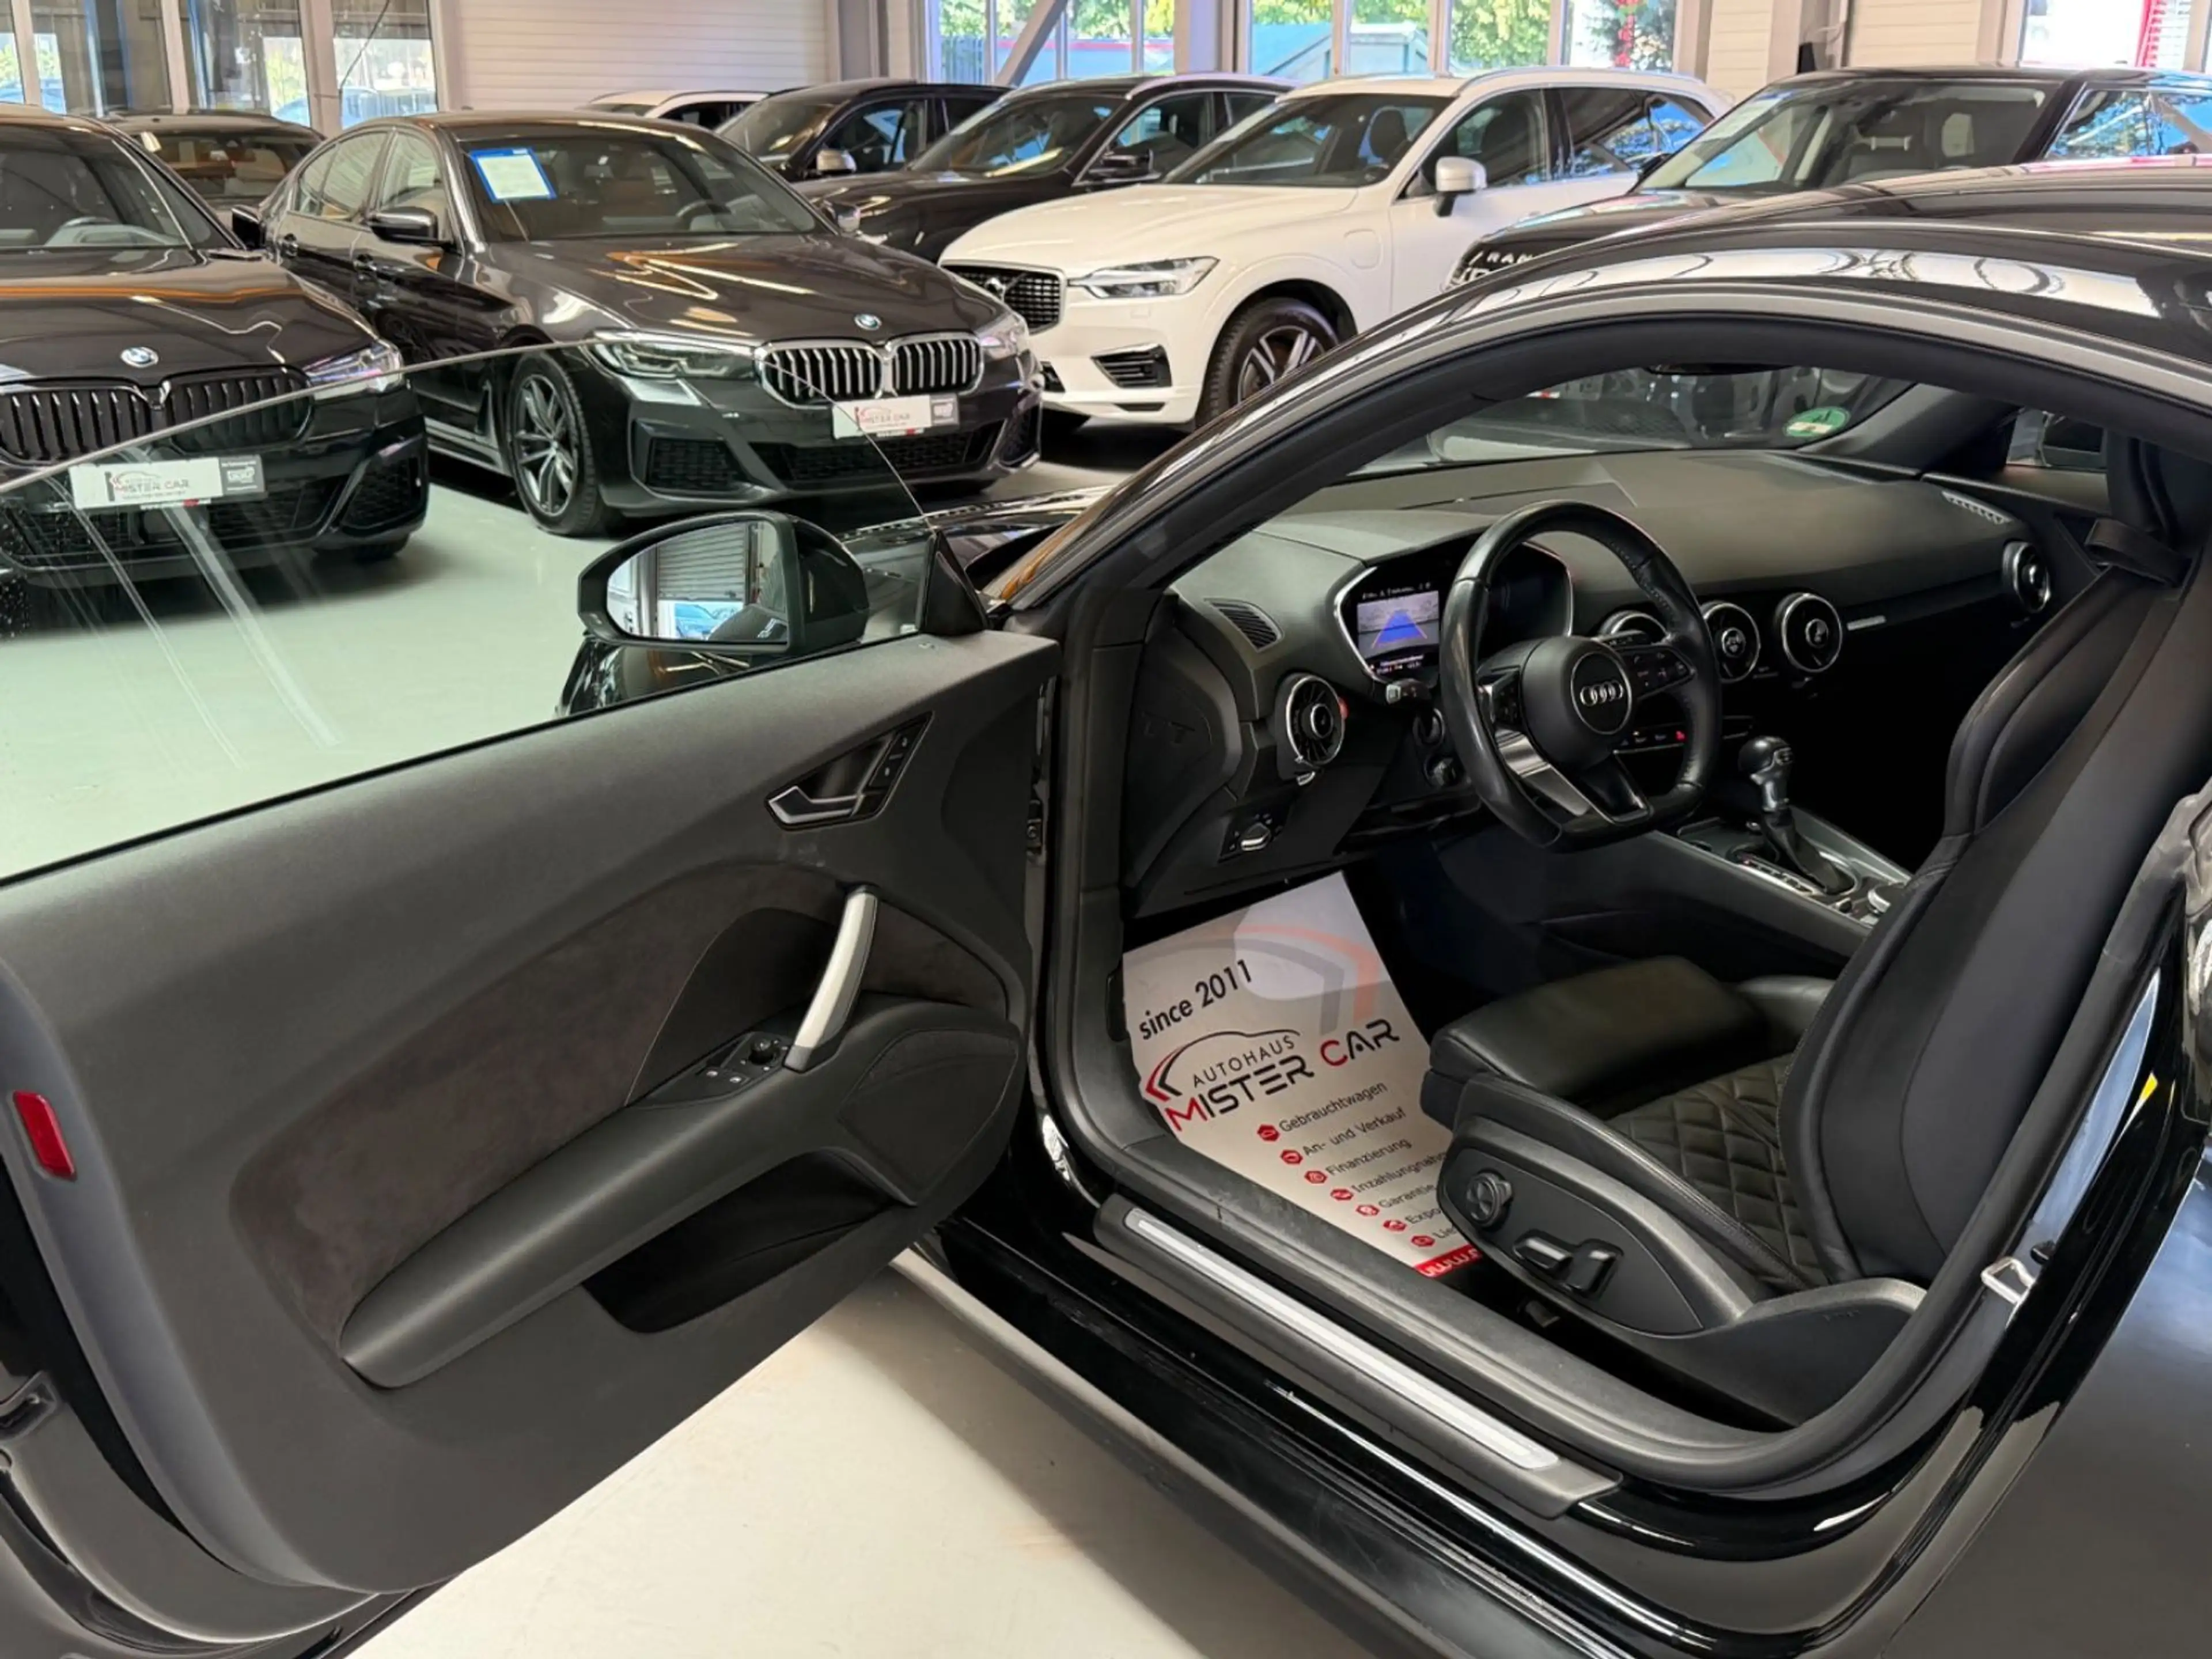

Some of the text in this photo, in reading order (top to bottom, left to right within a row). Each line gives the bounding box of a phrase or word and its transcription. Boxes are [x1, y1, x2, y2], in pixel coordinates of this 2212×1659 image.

[1139, 959, 1252, 1040] since 2011
[1165, 1018, 1400, 1132] MISTER CAR
[1193, 1035, 1295, 1089] AUTOHAUS
[1278, 1081, 1388, 1133] Gebrauchtwagen
[1301, 1105, 1407, 1157] An- und Verkauf
[1325, 1137, 1412, 1177] Finanzierung
